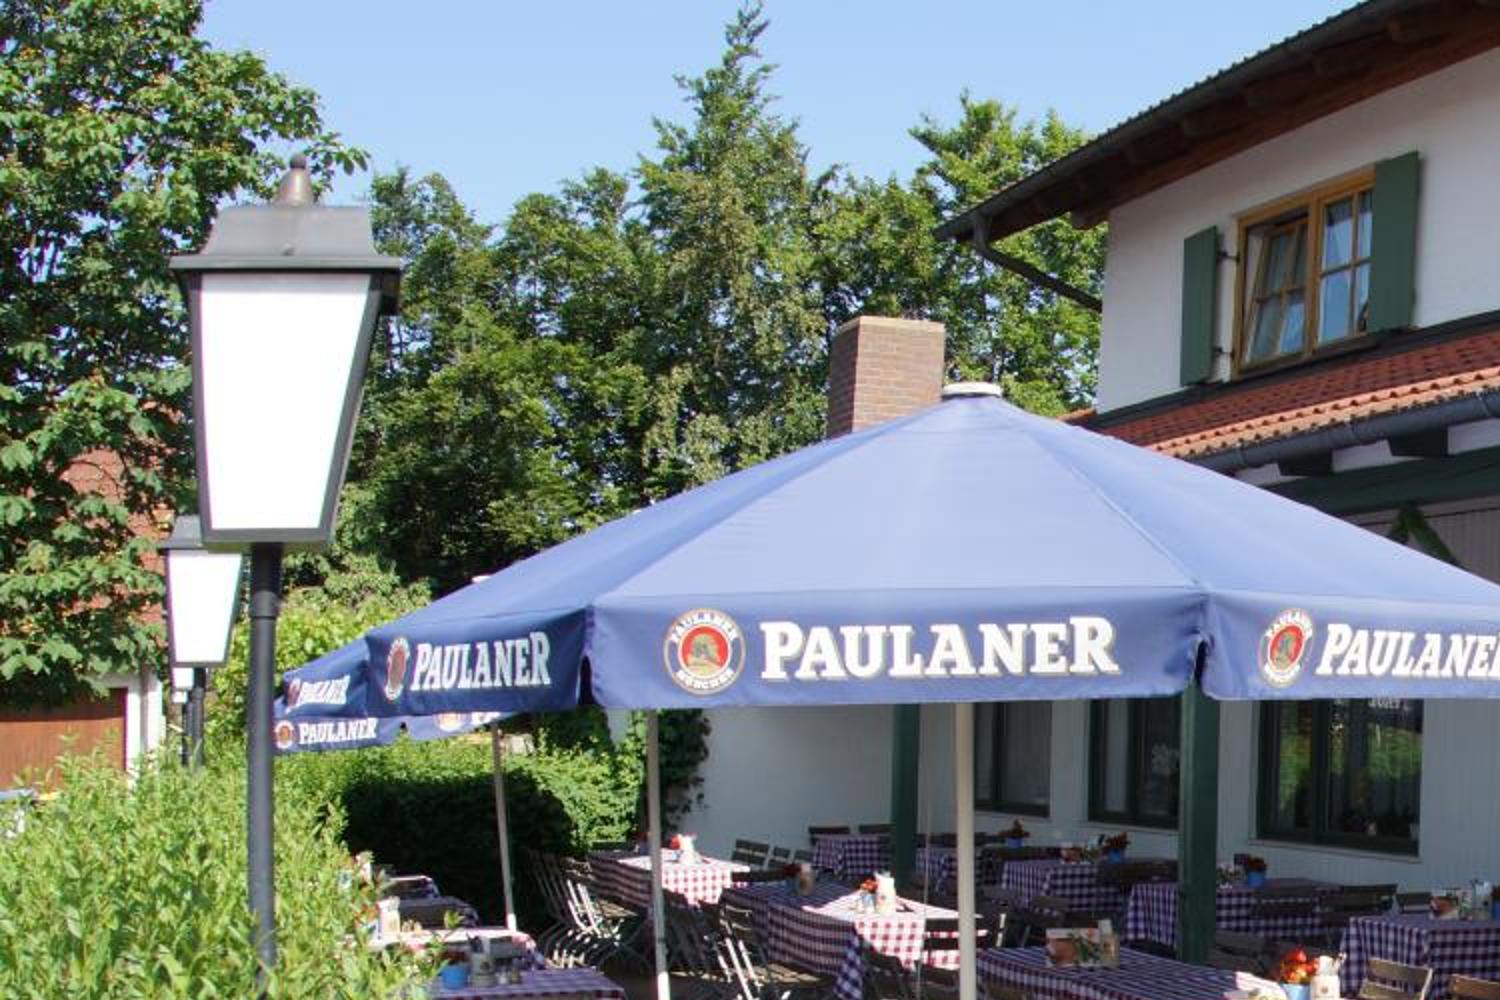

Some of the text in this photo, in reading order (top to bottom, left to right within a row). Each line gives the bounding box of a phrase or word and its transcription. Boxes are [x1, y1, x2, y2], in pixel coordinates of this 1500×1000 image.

[410, 631, 552, 692] PAULANER
[759, 616, 1121, 681] PAULANER
[298, 717, 378, 745] PAULANER
